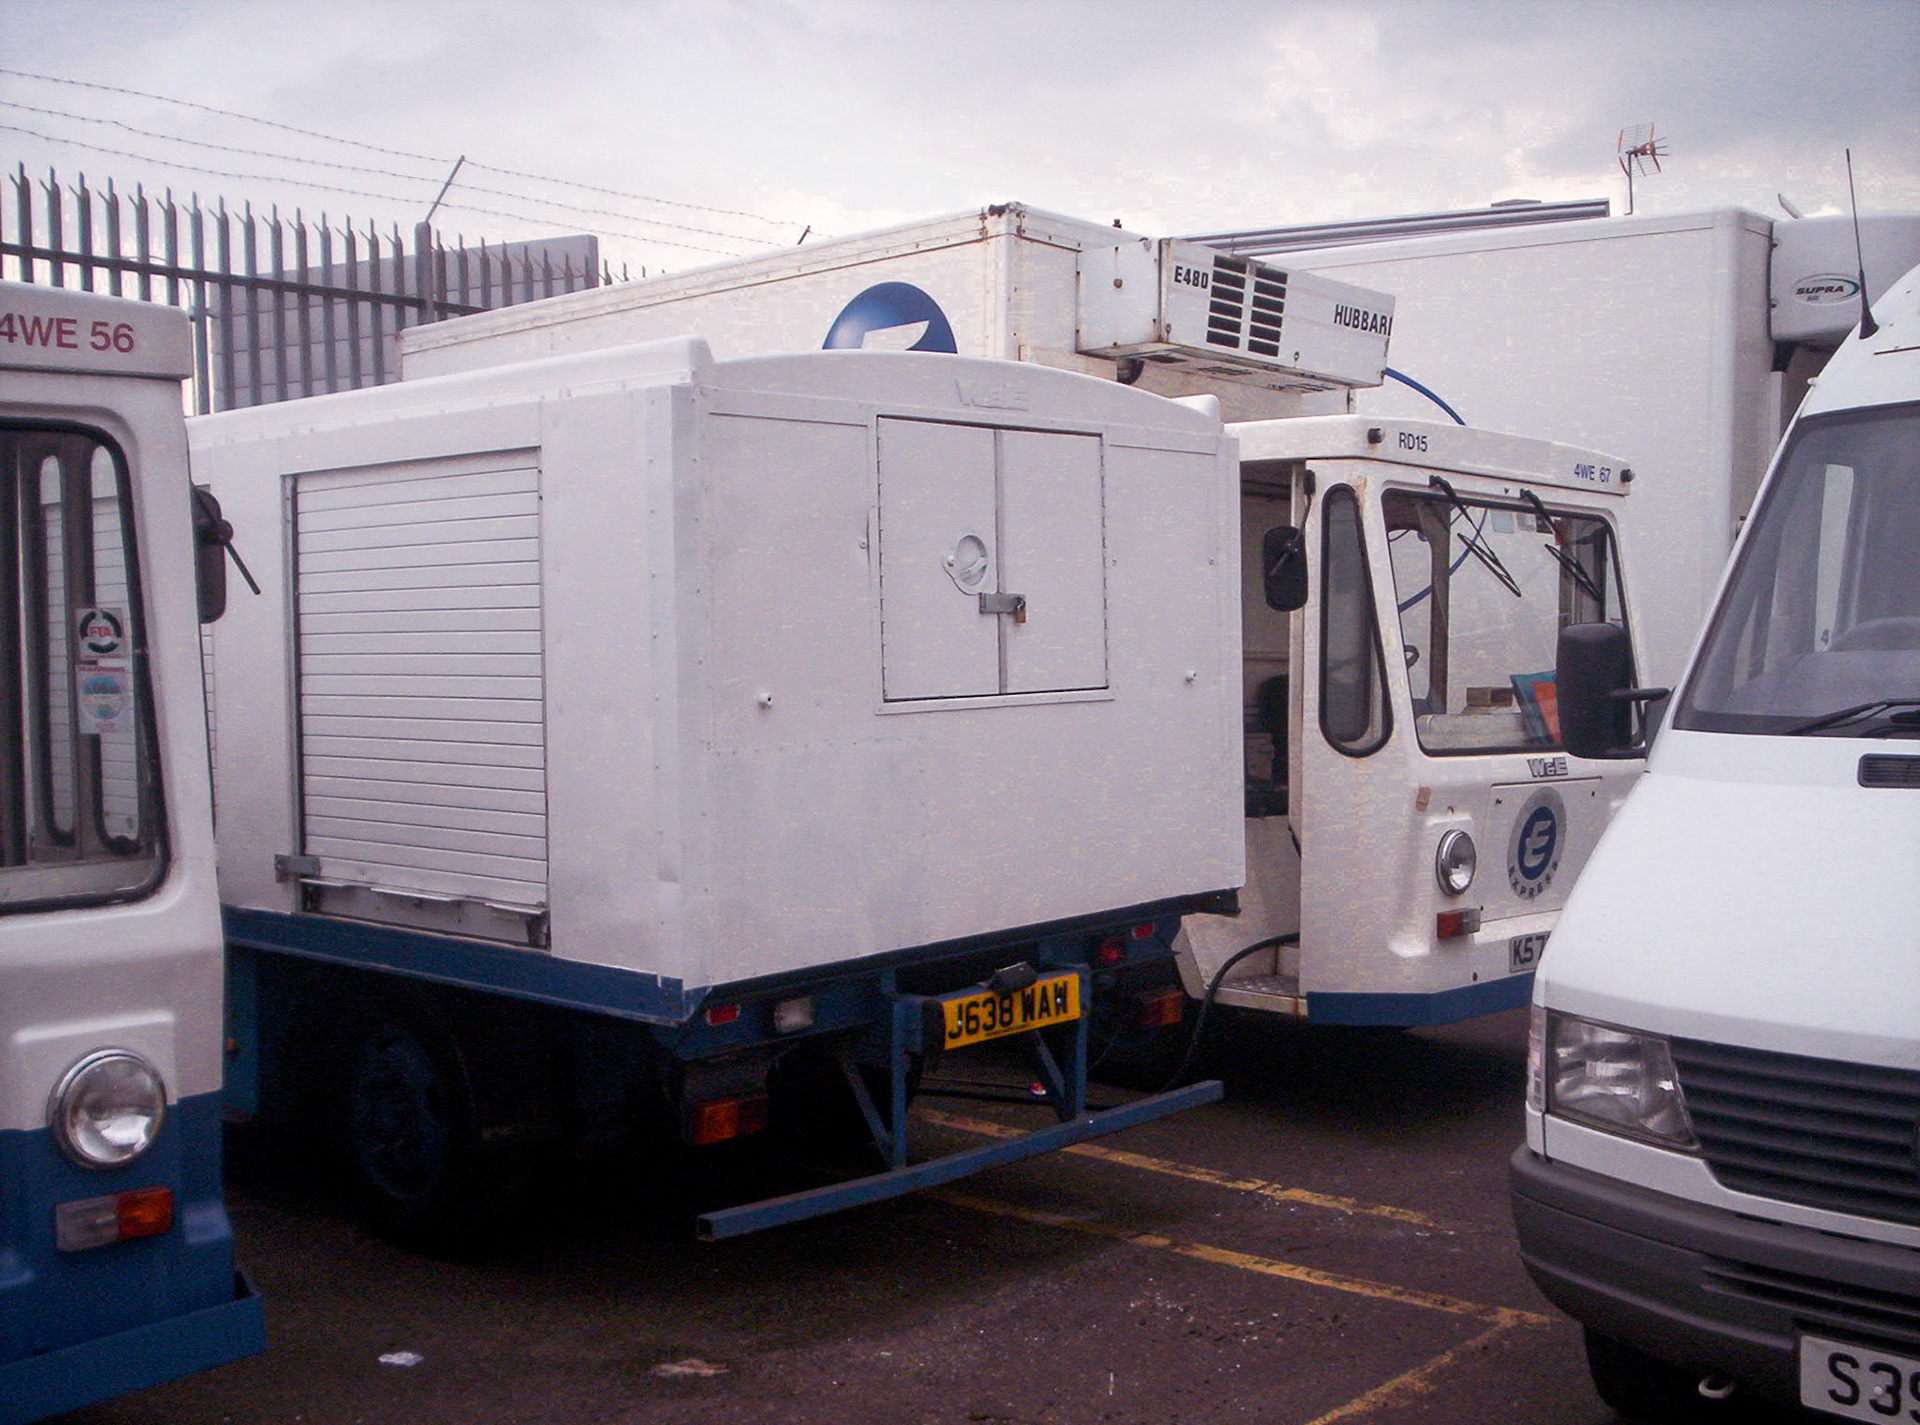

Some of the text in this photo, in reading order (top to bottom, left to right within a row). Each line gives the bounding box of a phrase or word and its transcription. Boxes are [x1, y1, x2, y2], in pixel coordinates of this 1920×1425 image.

[1174, 265, 1209, 289] E480
[1796, 285, 1844, 295] SUPRA
[1334, 303, 1393, 337] HUBBAR
[0, 312, 134, 353] 4WE 56
[1399, 432, 1428, 452] RD15
[1574, 463, 1612, 483] 4WE 67
[948, 991, 1013, 1039] J638
